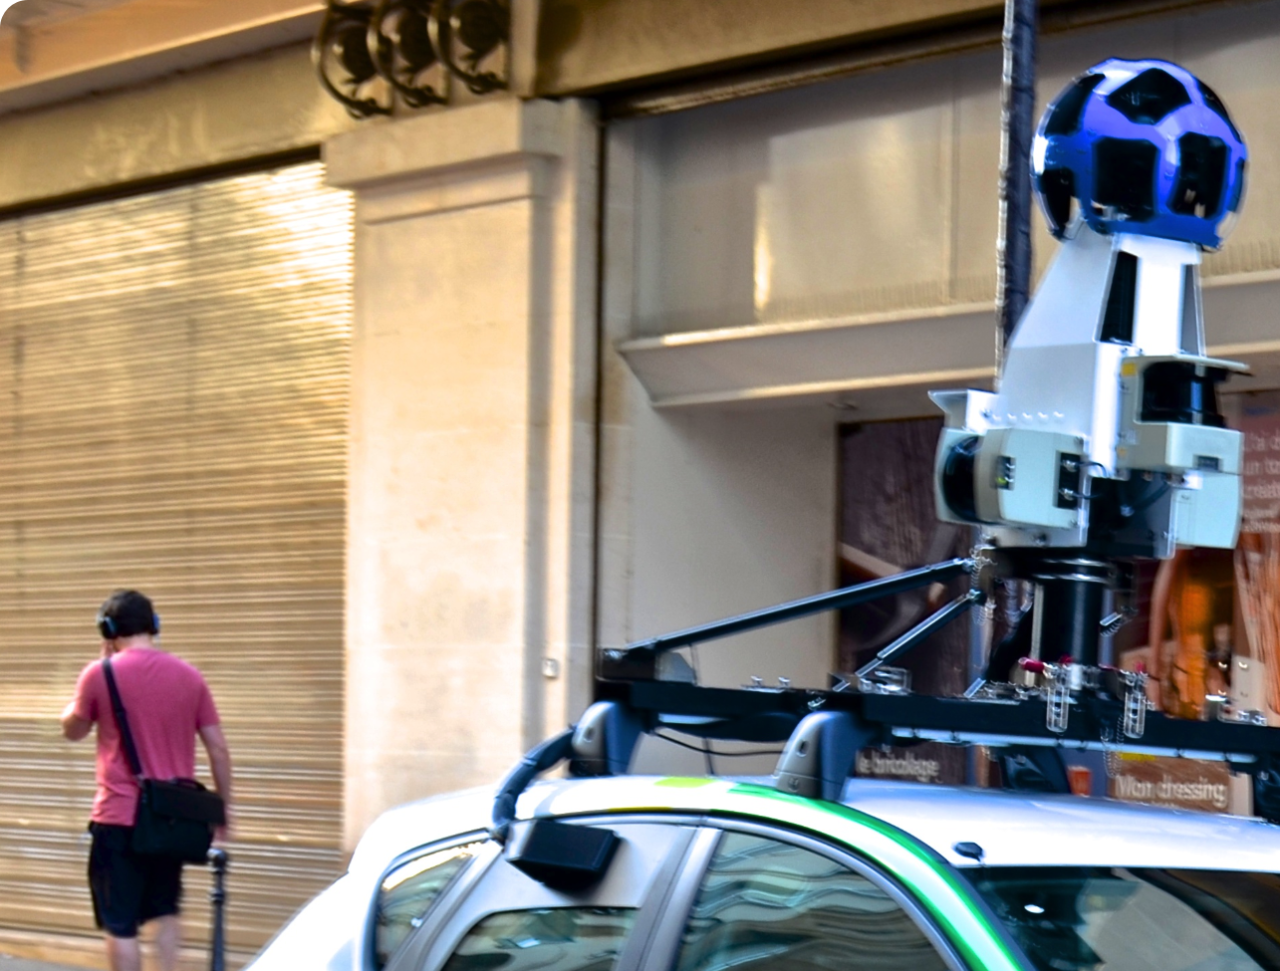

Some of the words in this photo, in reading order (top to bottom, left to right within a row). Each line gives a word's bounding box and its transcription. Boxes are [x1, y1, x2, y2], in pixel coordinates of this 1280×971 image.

[871, 749, 940, 783] bricolage
[1115, 774, 1156, 799] Mon
[1157, 773, 1229, 808] dressing
